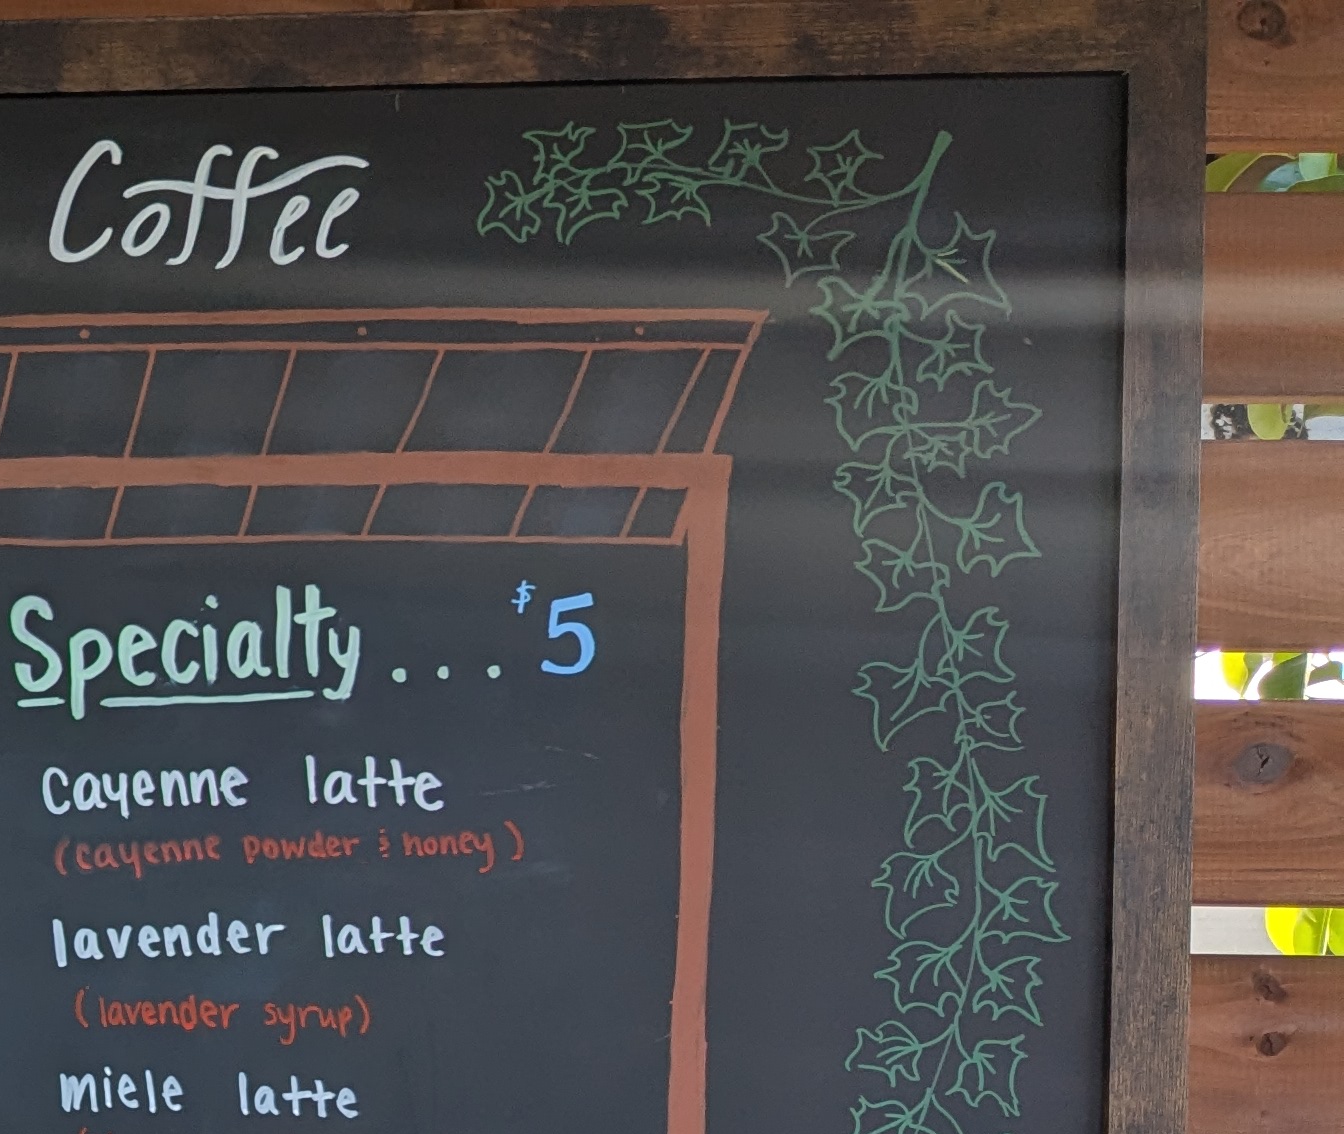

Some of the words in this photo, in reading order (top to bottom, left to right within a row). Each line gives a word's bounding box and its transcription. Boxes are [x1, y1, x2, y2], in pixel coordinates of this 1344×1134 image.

[48, 139, 370, 270] Coffee
[10, 584, 361, 721] Specialty
[510, 580, 596, 676] $5
[41, 764, 250, 819] cayenne
[305, 755, 446, 812] latte
[54, 831, 222, 879] (cayenne
[243, 829, 361, 865] powder
[402, 820, 526, 874] honey)
[52, 911, 287, 968] lavender
[321, 914, 446, 959] latte
[74, 985, 240, 1032] (lavender
[263, 994, 373, 1046] syrup)
[59, 1065, 185, 1114] miele
[238, 1071, 360, 1119] latte
